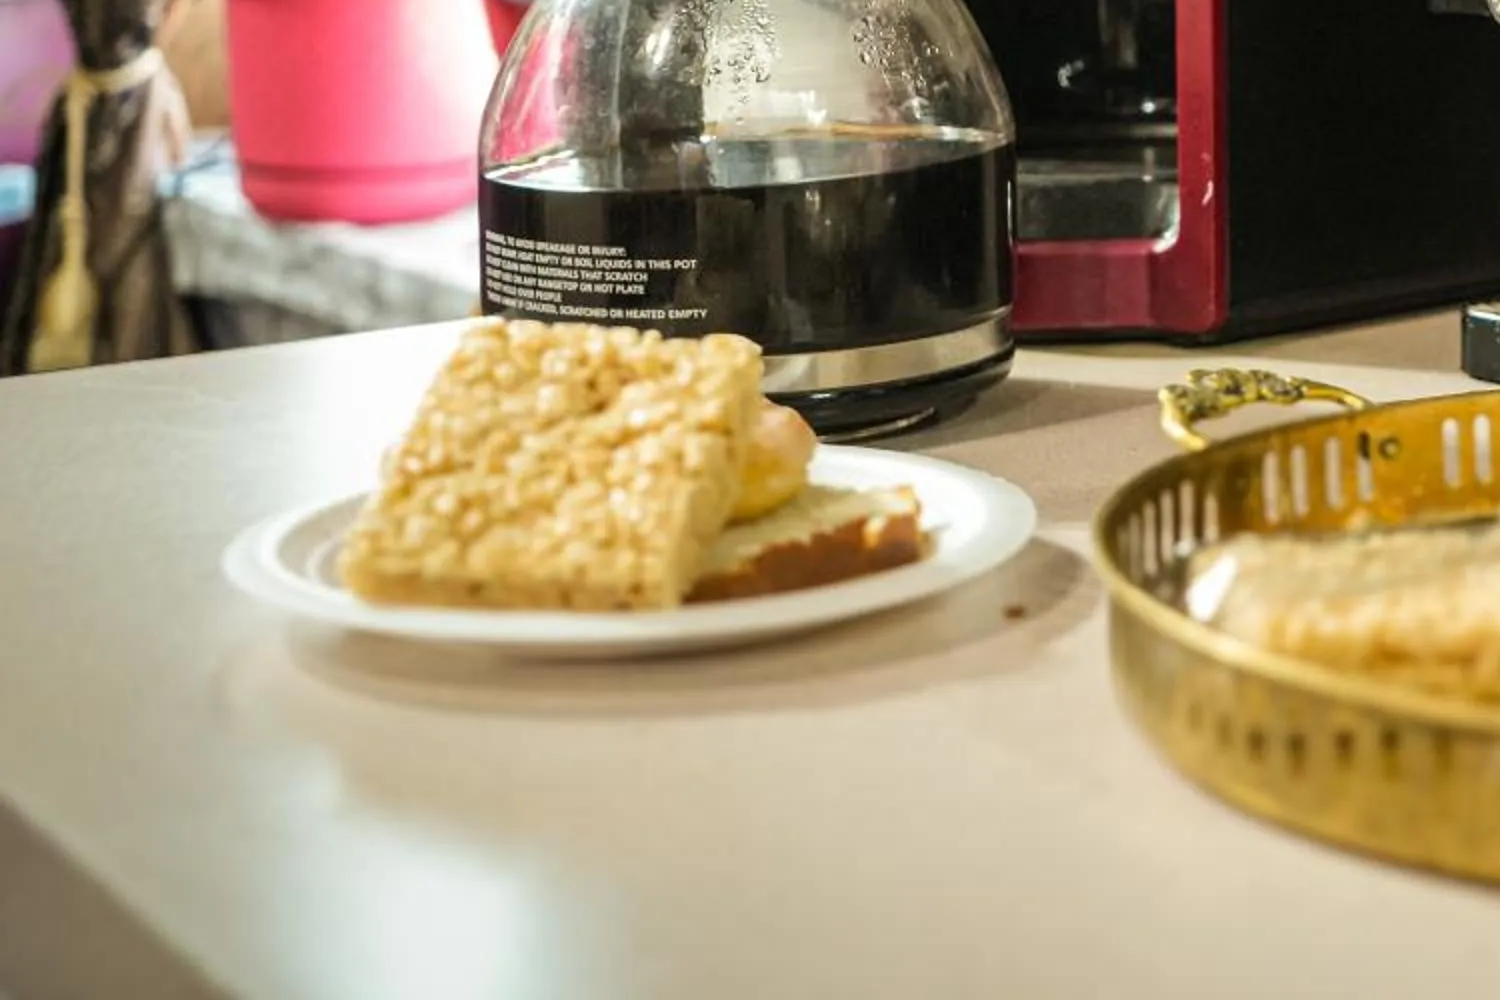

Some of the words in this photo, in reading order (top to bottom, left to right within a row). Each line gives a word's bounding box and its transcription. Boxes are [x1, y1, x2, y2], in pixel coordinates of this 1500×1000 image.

[577, 245, 590, 255] OR
[535, 254, 559, 265] EMPTY
[561, 256, 573, 266] OR
[574, 257, 593, 268] BOIL
[595, 259, 633, 270] LIQUIDS
[634, 259, 646, 269] IN
[648, 259, 671, 270] THIS
[673, 259, 697, 269] POT
[537, 266, 579, 279] MATERIALS
[580, 271, 603, 281] THAT
[604, 272, 648, 283] SCRATCH
[580, 283, 592, 292] OR
[594, 284, 613, 294] HOT
[616, 284, 645, 295] PLATE
[610, 309, 624, 318] OR
[626, 309, 666, 319] HEATED
[668, 309, 708, 319] EMPTY
